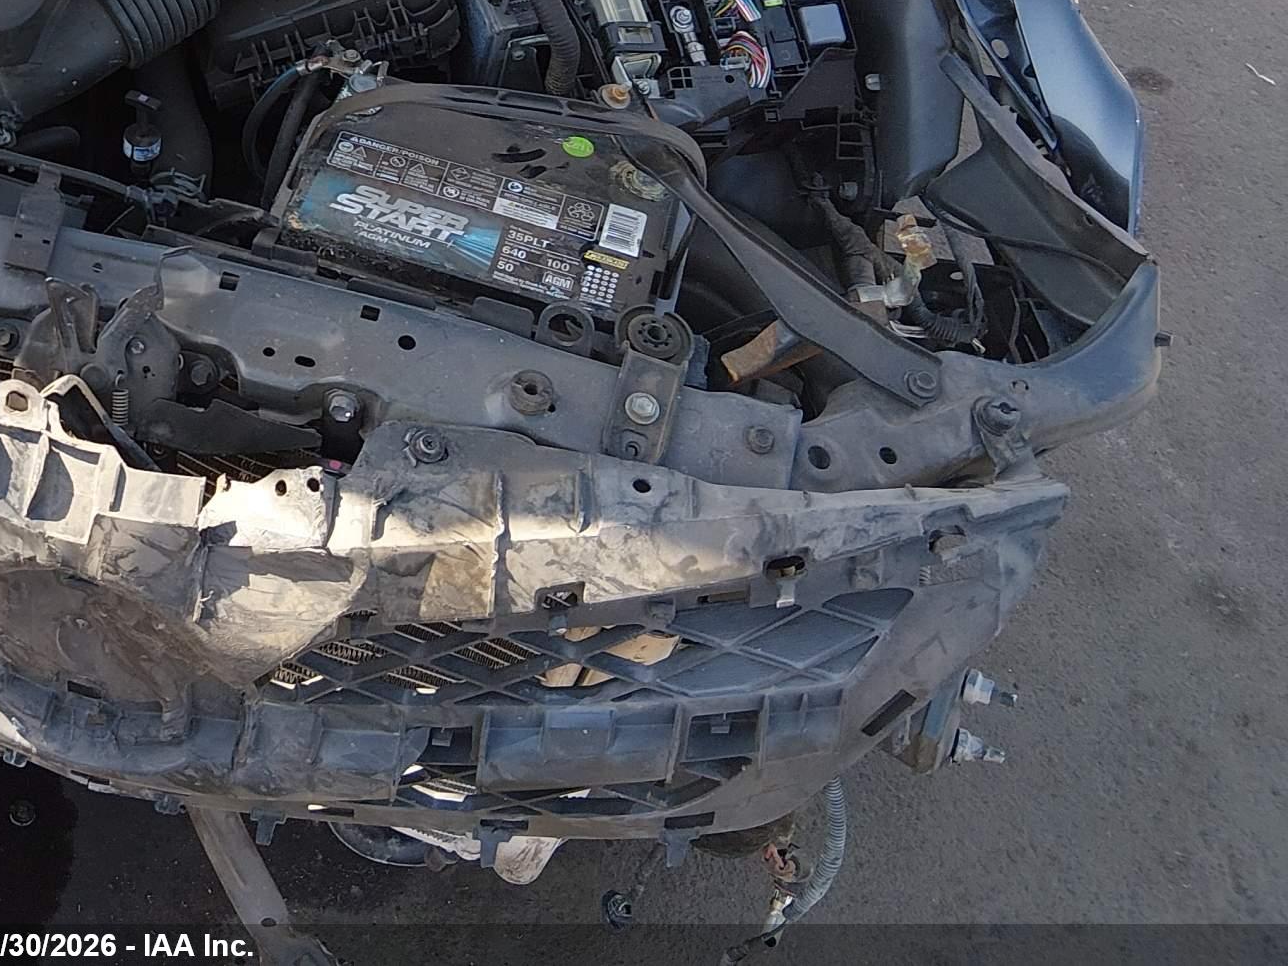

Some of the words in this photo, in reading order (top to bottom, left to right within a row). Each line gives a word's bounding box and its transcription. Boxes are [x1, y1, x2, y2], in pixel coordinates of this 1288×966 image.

[329, 193, 468, 244] START
[355, 185, 470, 231] SUPER
[353, 219, 432, 249] PLATINUM
[508, 229, 551, 249] 35PLT
[496, 260, 515, 273] 50
[501, 244, 527, 260] 640
[546, 258, 570, 273] 100
[544, 273, 572, 290] AGM
